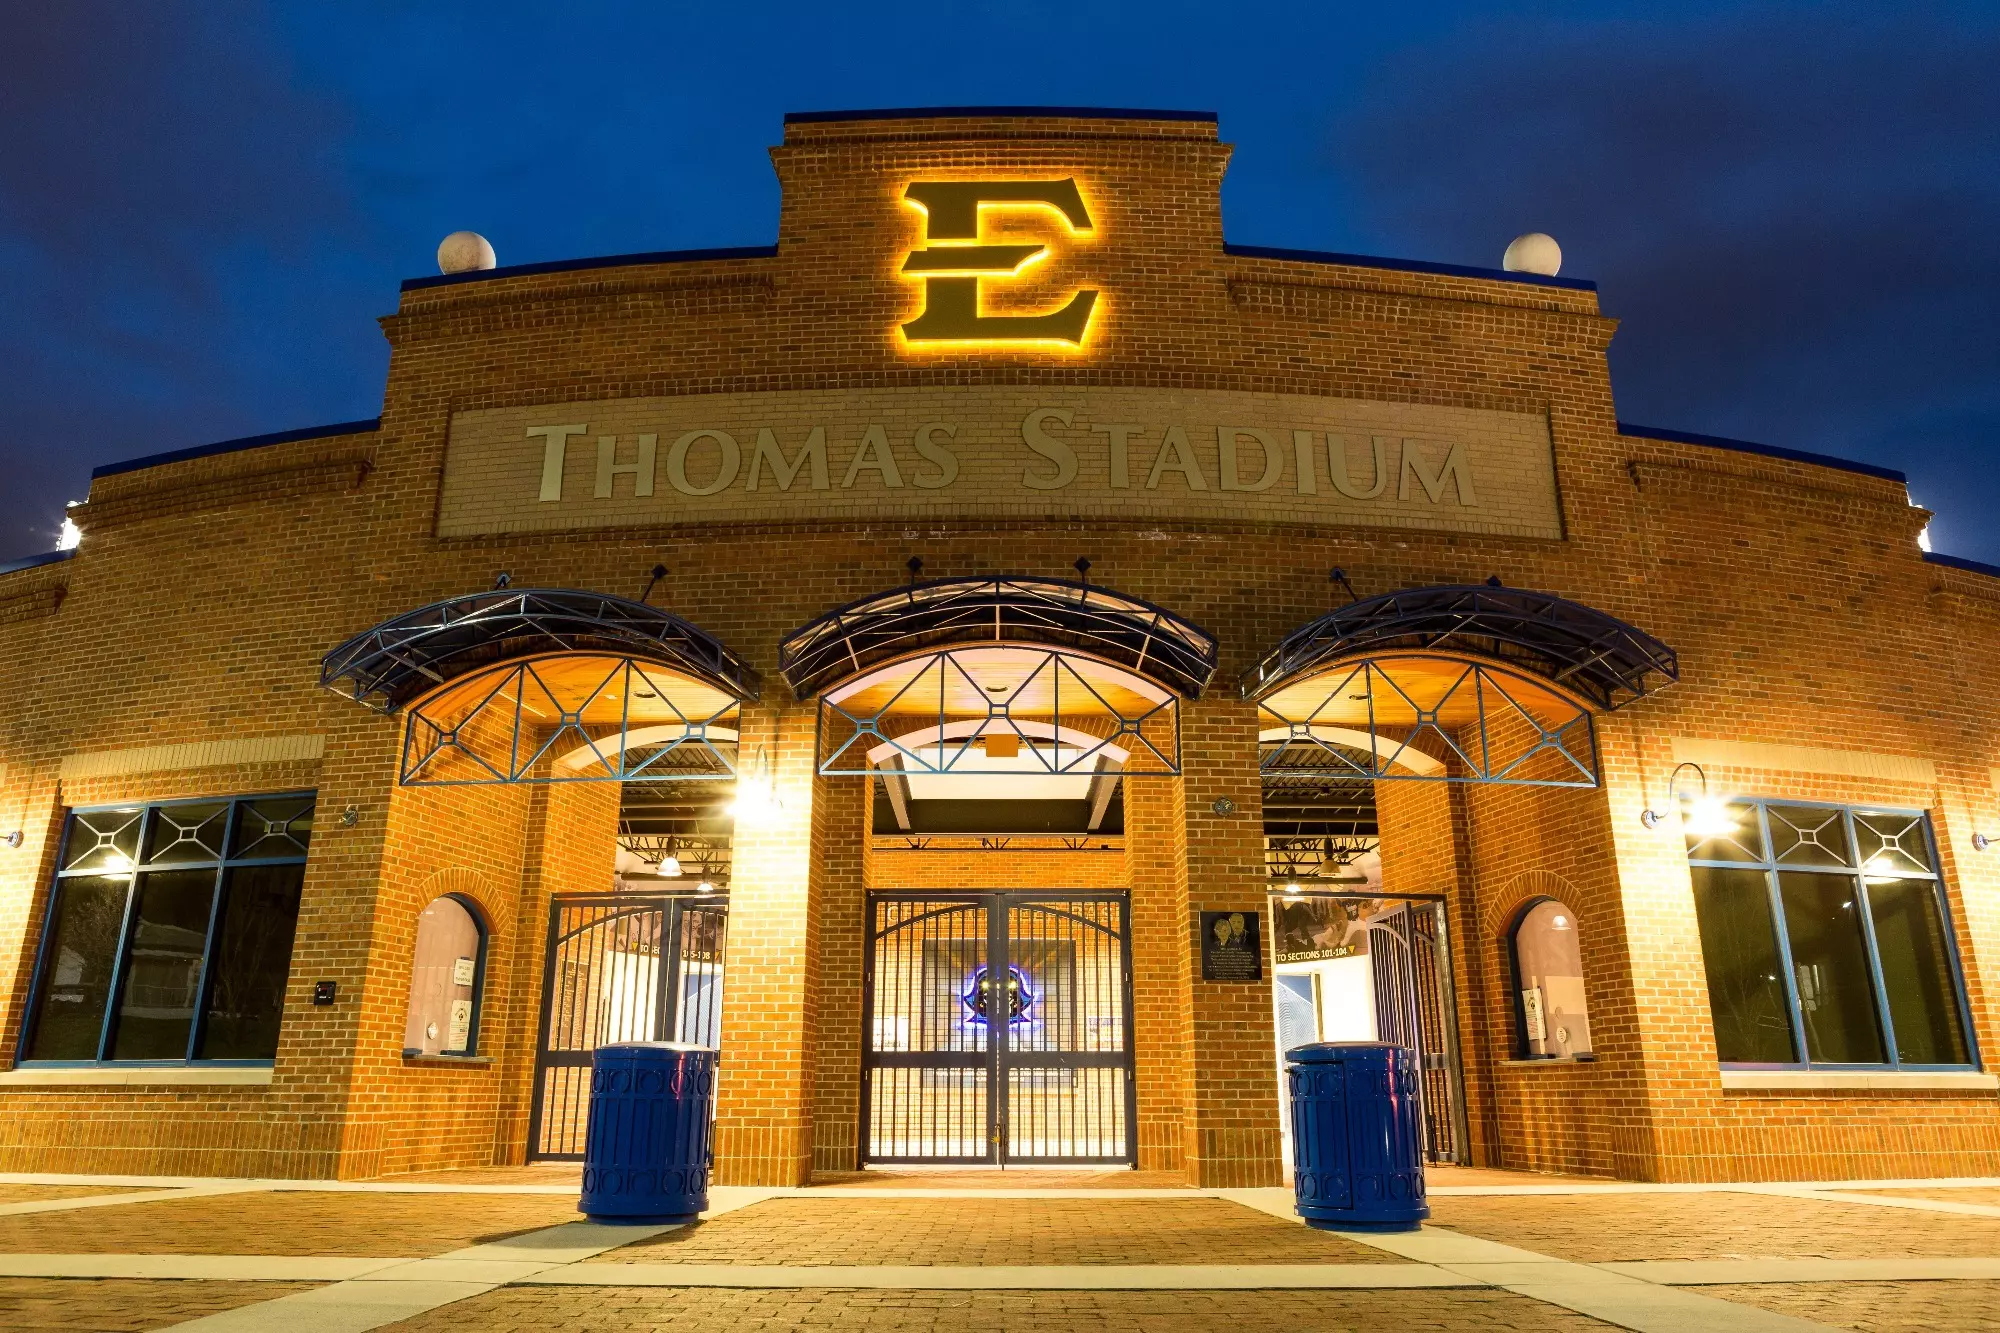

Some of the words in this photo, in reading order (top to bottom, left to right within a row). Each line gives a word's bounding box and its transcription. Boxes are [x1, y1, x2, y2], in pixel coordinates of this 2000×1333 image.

[901, 177, 1099, 346] E
[526, 421, 960, 502] THOMAS
[1021, 407, 1478, 507] STADIUM
[682, 949, 711, 960] 15-108
[1276, 954, 1287, 962] TO
[1287, 950, 1320, 961] SECTIONS
[1321, 947, 1347, 958] 101-104
